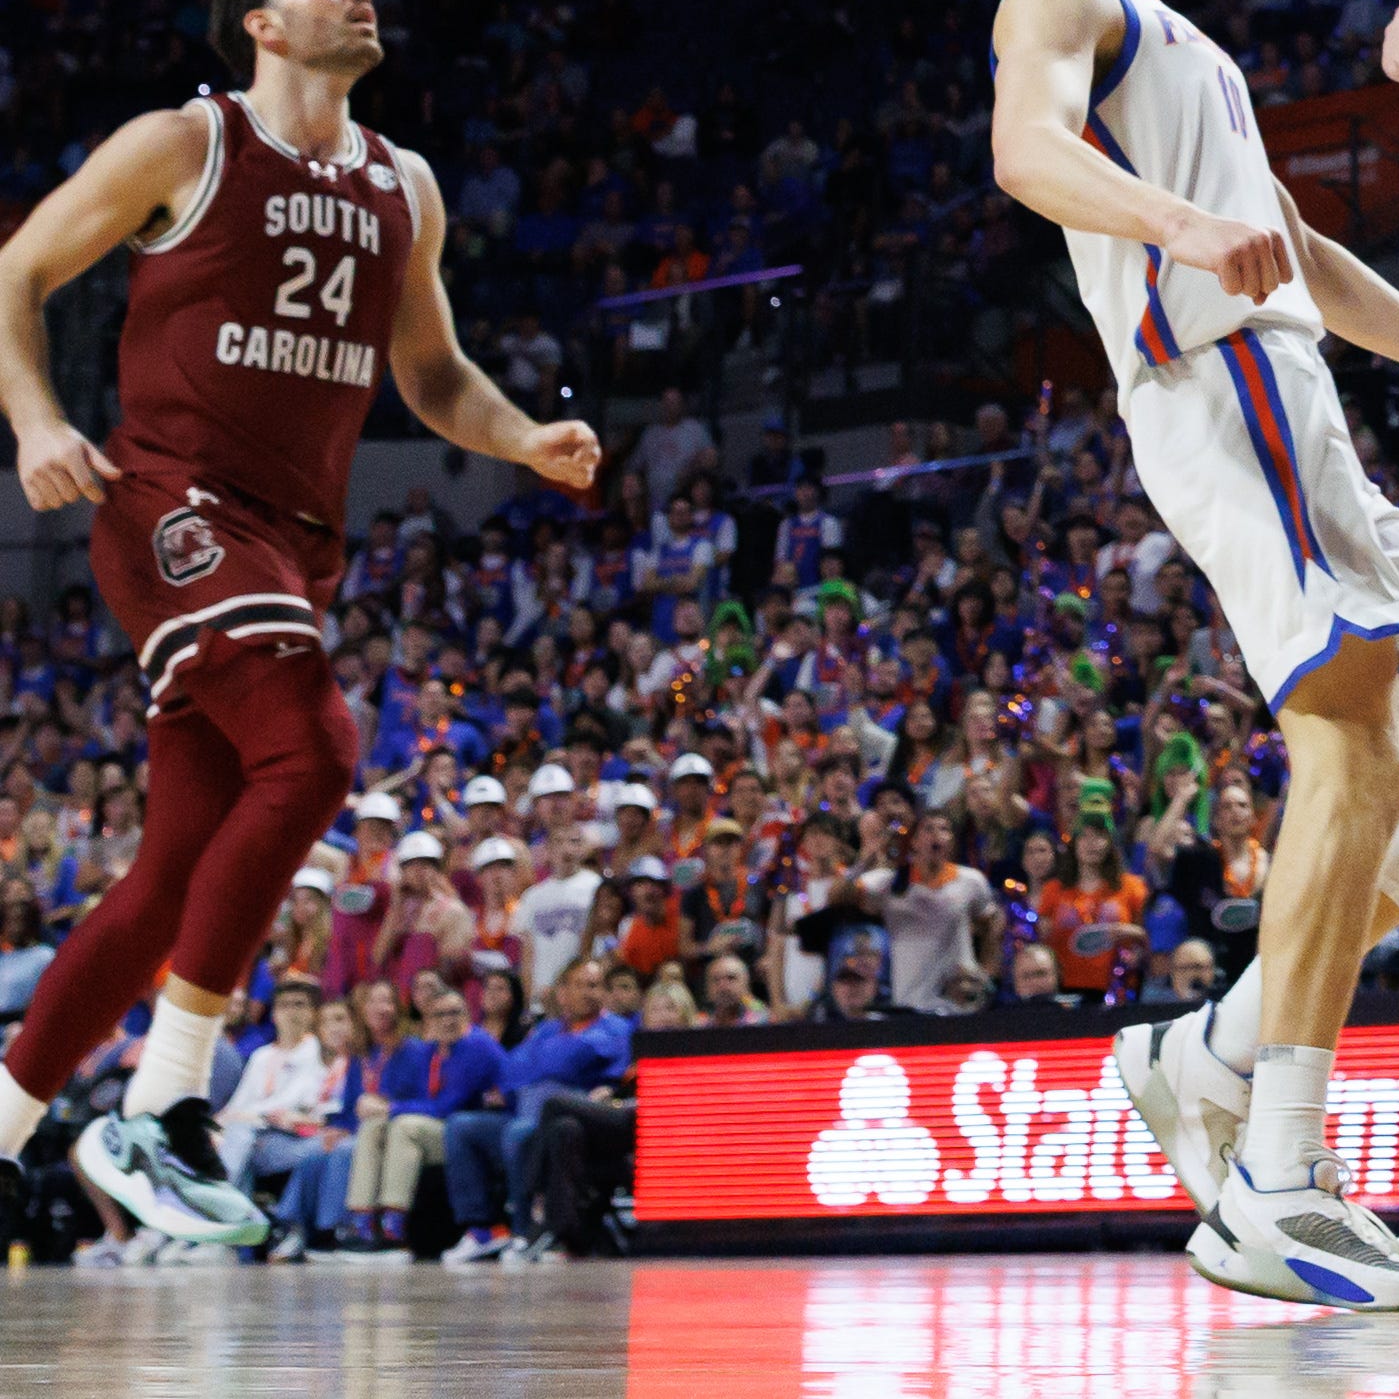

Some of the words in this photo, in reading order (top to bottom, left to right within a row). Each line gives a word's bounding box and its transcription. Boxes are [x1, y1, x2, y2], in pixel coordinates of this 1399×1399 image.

[264, 192, 381, 255] SOUTH
[273, 246, 358, 327] 24
[216, 321, 375, 389] CAROLINA
